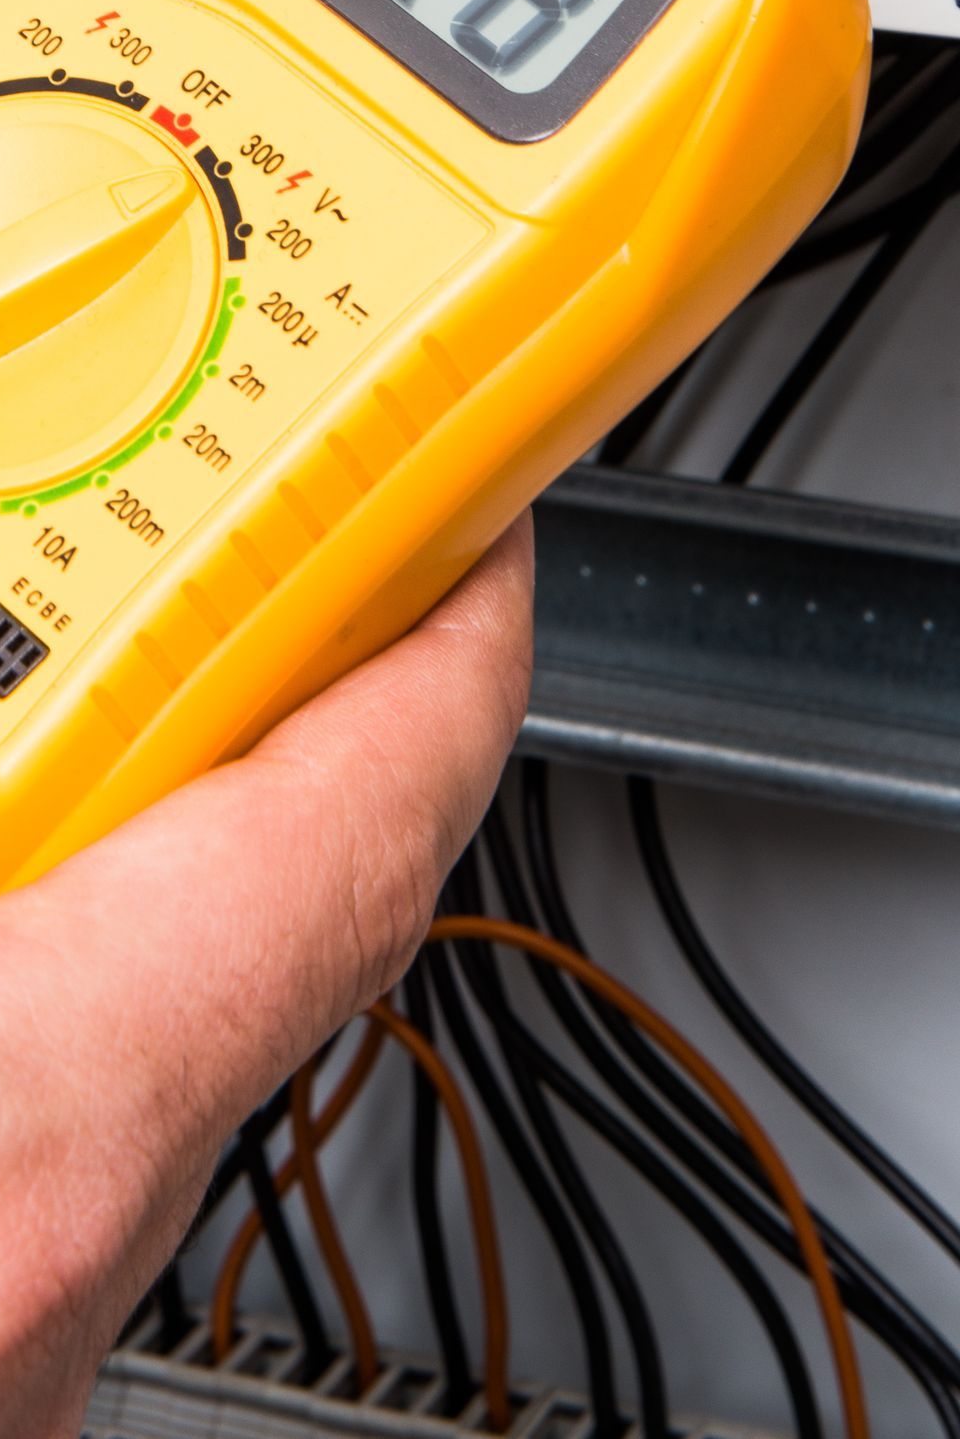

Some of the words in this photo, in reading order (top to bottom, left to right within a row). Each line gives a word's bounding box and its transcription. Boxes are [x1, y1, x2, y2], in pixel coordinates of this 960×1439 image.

[18, 18, 63, 56] 200
[110, 28, 153, 66] 300
[180, 70, 232, 109] OFF
[240, 134, 285, 175] 300
[265, 219, 312, 260] 200
[228, 364, 267, 402] 2m
[182, 424, 233, 472] 20m
[105, 488, 166, 548] 200m
[33, 526, 77, 572] 10A
